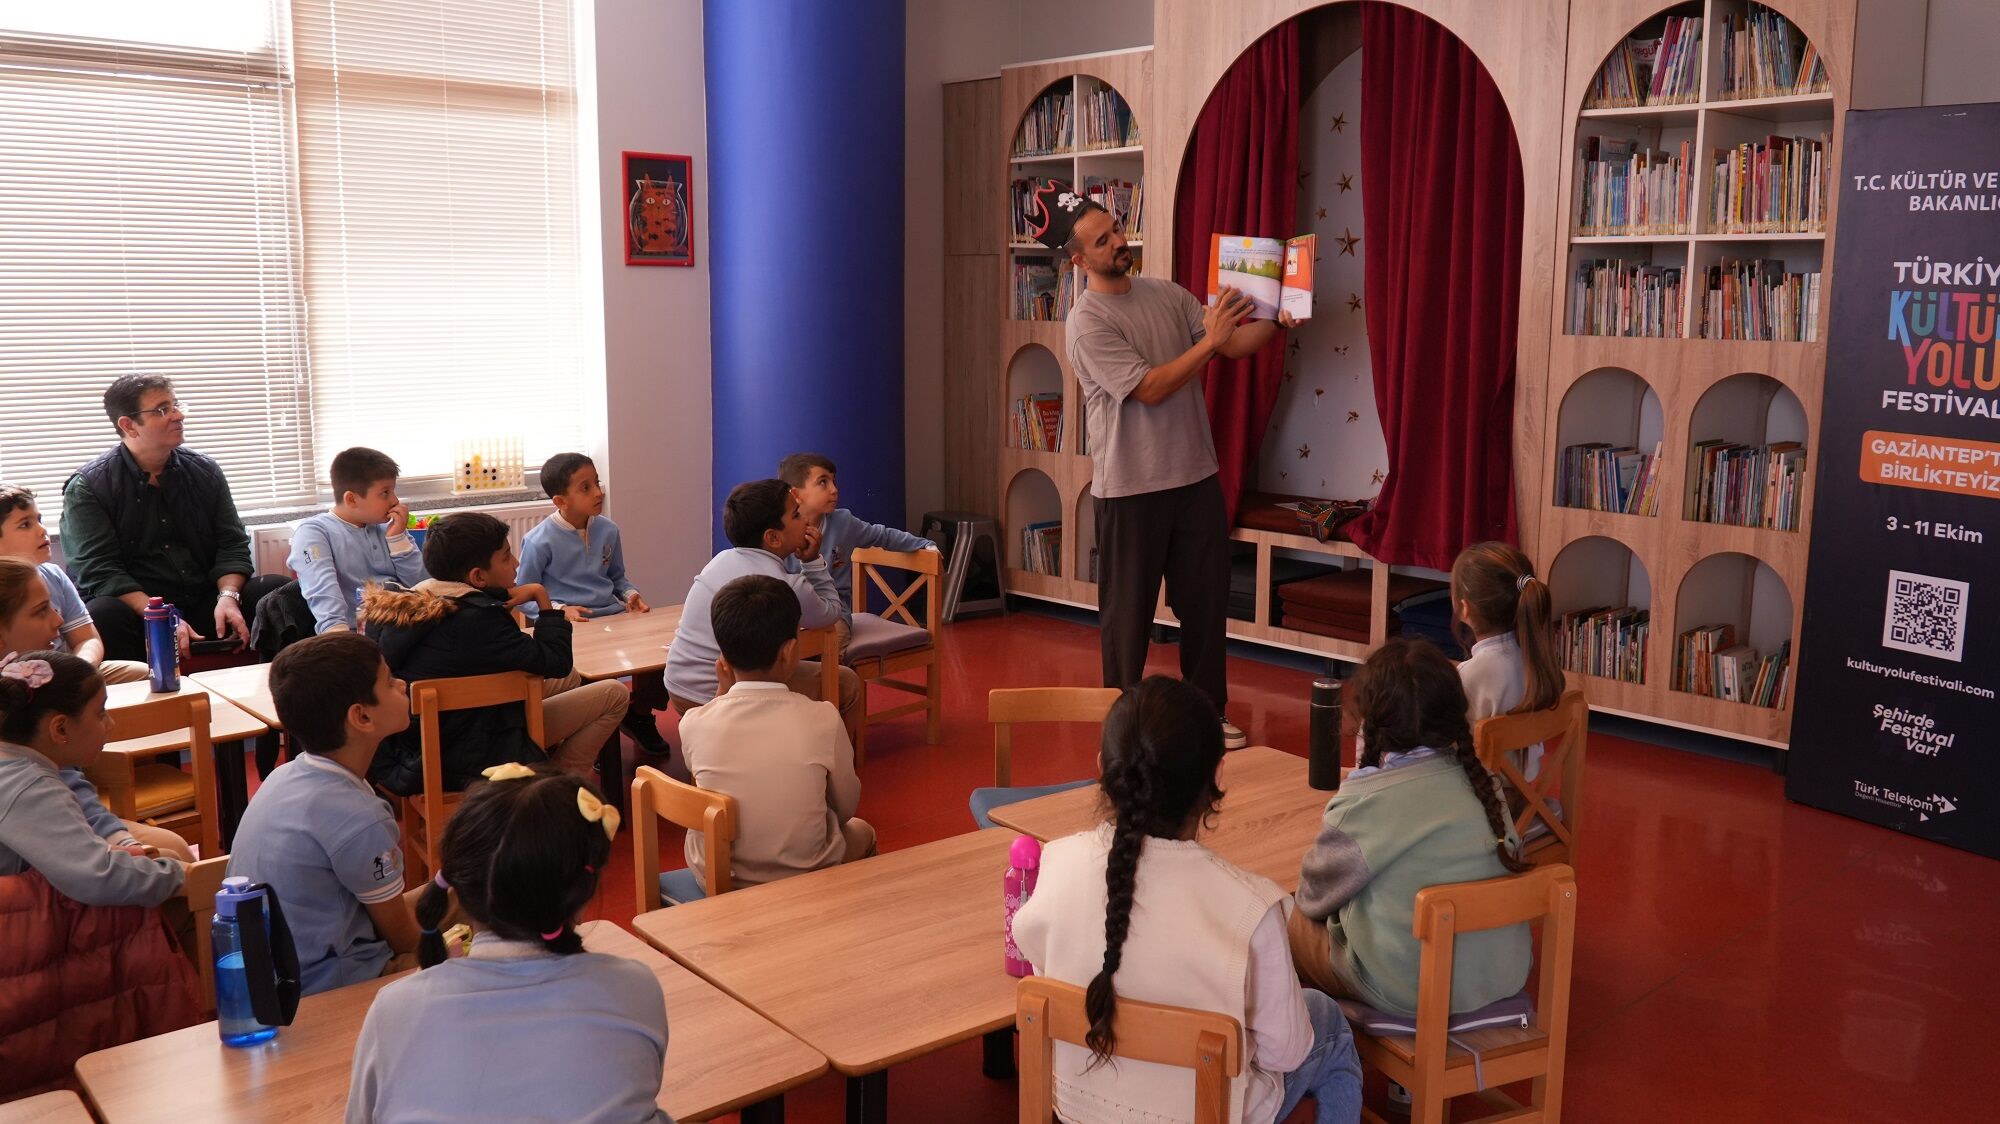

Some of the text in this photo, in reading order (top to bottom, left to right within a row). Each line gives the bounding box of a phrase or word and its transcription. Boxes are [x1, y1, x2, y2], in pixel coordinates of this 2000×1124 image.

[1854, 169, 1999, 191] T.C. KÜLTÜR VE
[1909, 194, 2000, 211] BAKANLI
[1888, 290, 2000, 347] KÜLTÜ
[1904, 338, 2000, 391] YOLU
[1880, 460, 2000, 492] BİRLİKTEYİZ
[1886, 516, 1898, 531] 3
[1914, 520, 1930, 536] 11
[1934, 522, 1983, 544] Ekim
[1846, 656, 1995, 699] kulturyolufestivali.com
[1872, 703, 1935, 729] Şehirde
[1880, 718, 1955, 748] Festival
[1906, 737, 1941, 757] Var!
[1854, 780, 1880, 796] Türk
[1883, 788, 1933, 812] Telekom
